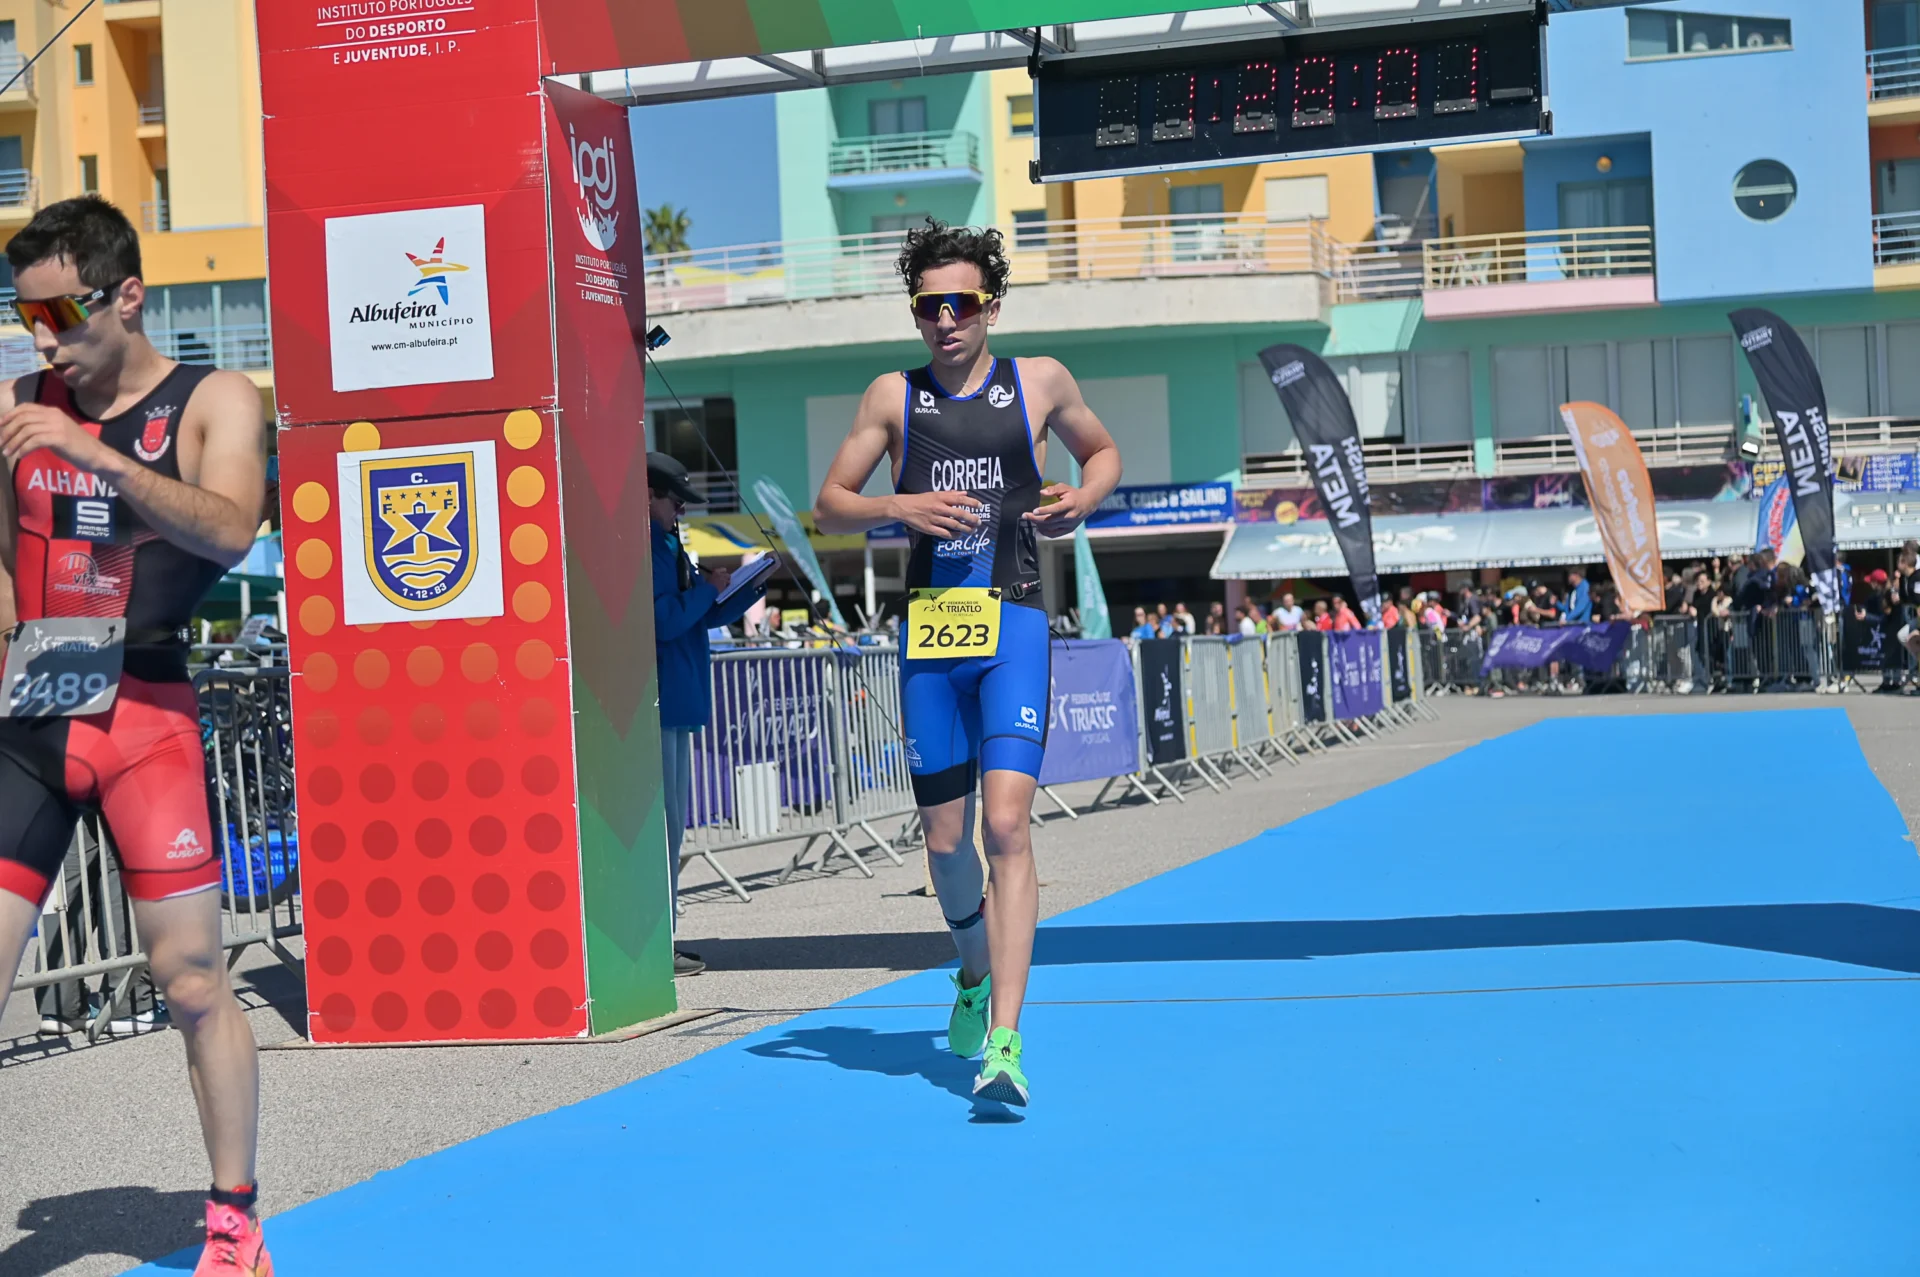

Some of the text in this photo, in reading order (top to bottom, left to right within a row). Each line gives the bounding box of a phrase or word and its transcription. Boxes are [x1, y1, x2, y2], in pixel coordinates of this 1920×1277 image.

[317, 1, 386, 20] INSTITUTO
[345, 18, 446, 40] DO DESPORTO
[333, 40, 461, 65] E JUVENTUDE, I. P.
[569, 121, 617, 210] ipdj
[575, 254, 628, 274] INSTITUTO PORTUGUÊS
[585, 272, 620, 289] DO DESPORTO
[585, 290, 615, 306] JUVENTUDE,
[349, 301, 437, 324] Albufeira
[409, 316, 474, 329] MUNICÍPIO
[371, 336, 458, 352] www.cm-albufeira.pt
[410, 472, 429, 484] C.
[931, 457, 1004, 492] CORREIA
[1179, 486, 1226, 506] SAILING
[383, 499, 457, 514] F. F.
[946, 605, 982, 613] TRIATLO
[918, 624, 990, 648] 2623
[51, 641, 99, 653] TRIATLO
[10, 672, 107, 707] 3489
